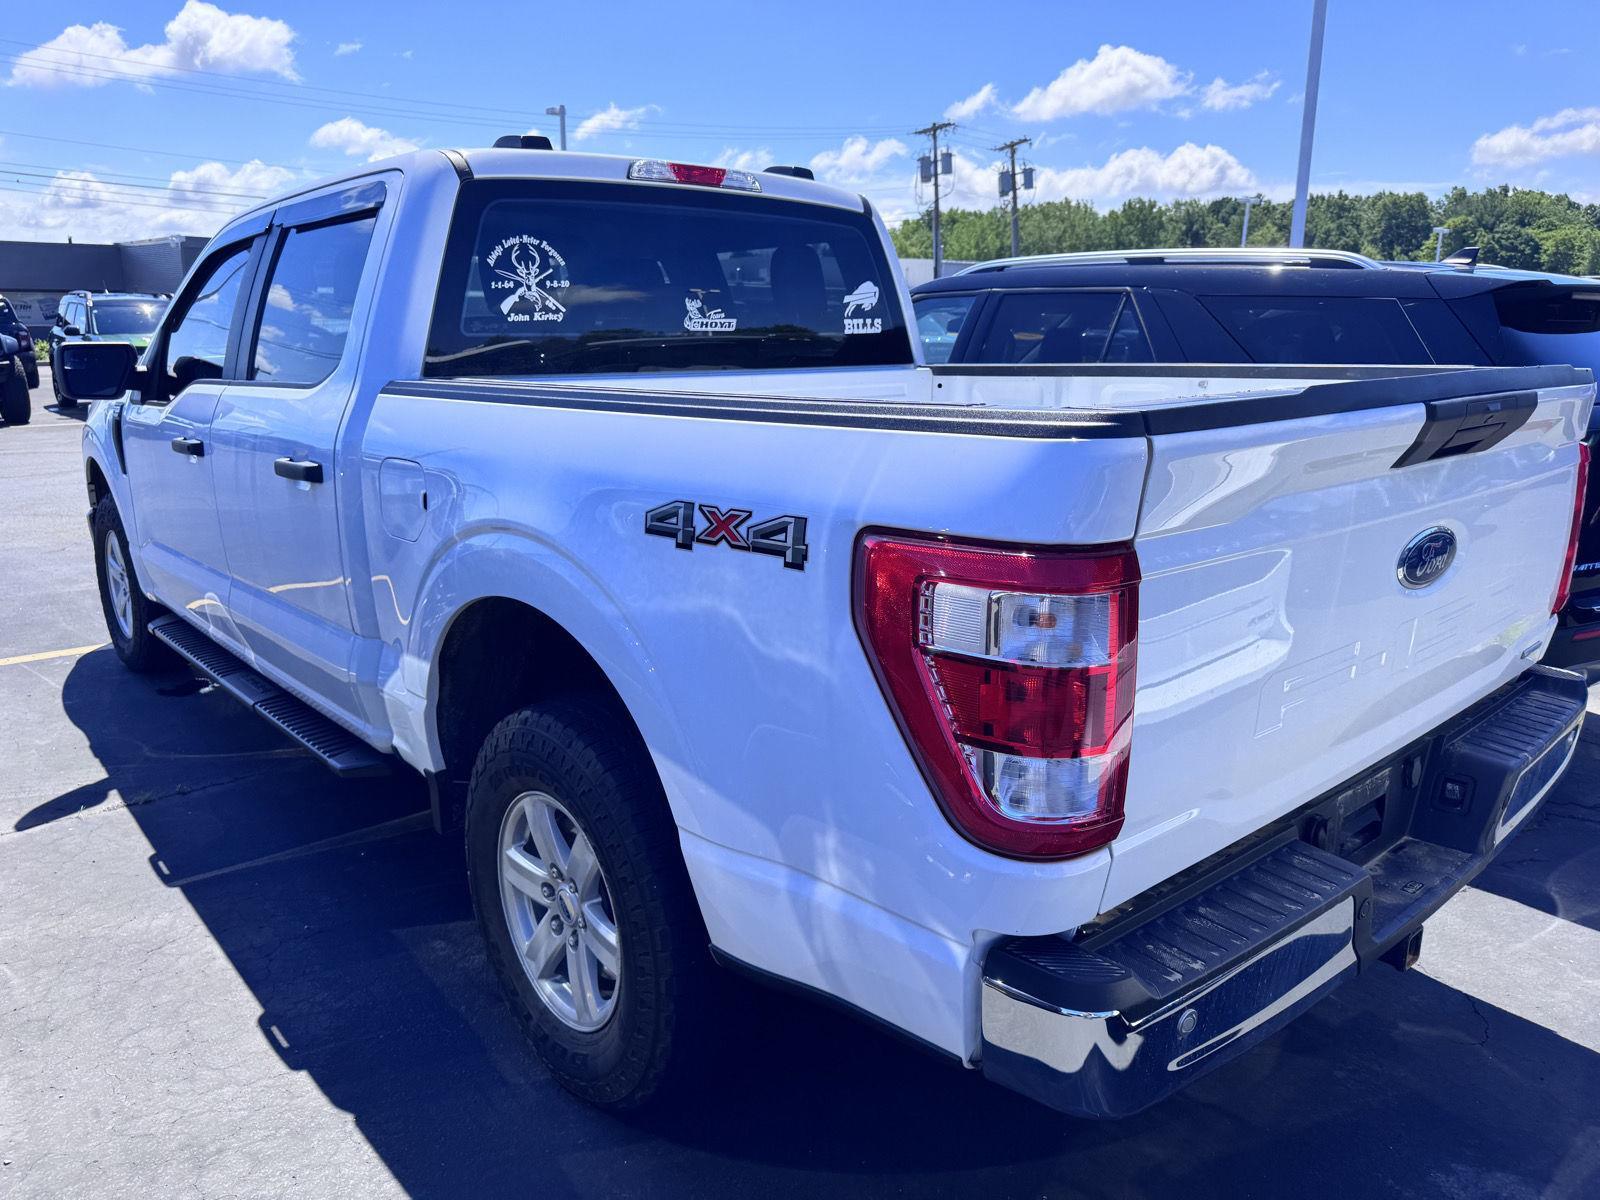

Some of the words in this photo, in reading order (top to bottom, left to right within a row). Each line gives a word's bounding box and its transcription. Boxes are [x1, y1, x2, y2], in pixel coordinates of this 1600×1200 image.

[486, 245, 503, 267] Always
[541, 240, 566, 266] Forgotten
[491, 281, 514, 289] 1-1-64
[507, 312, 530, 322] John
[699, 320, 735, 329] HOYT
[843, 318, 882, 335] BILLS
